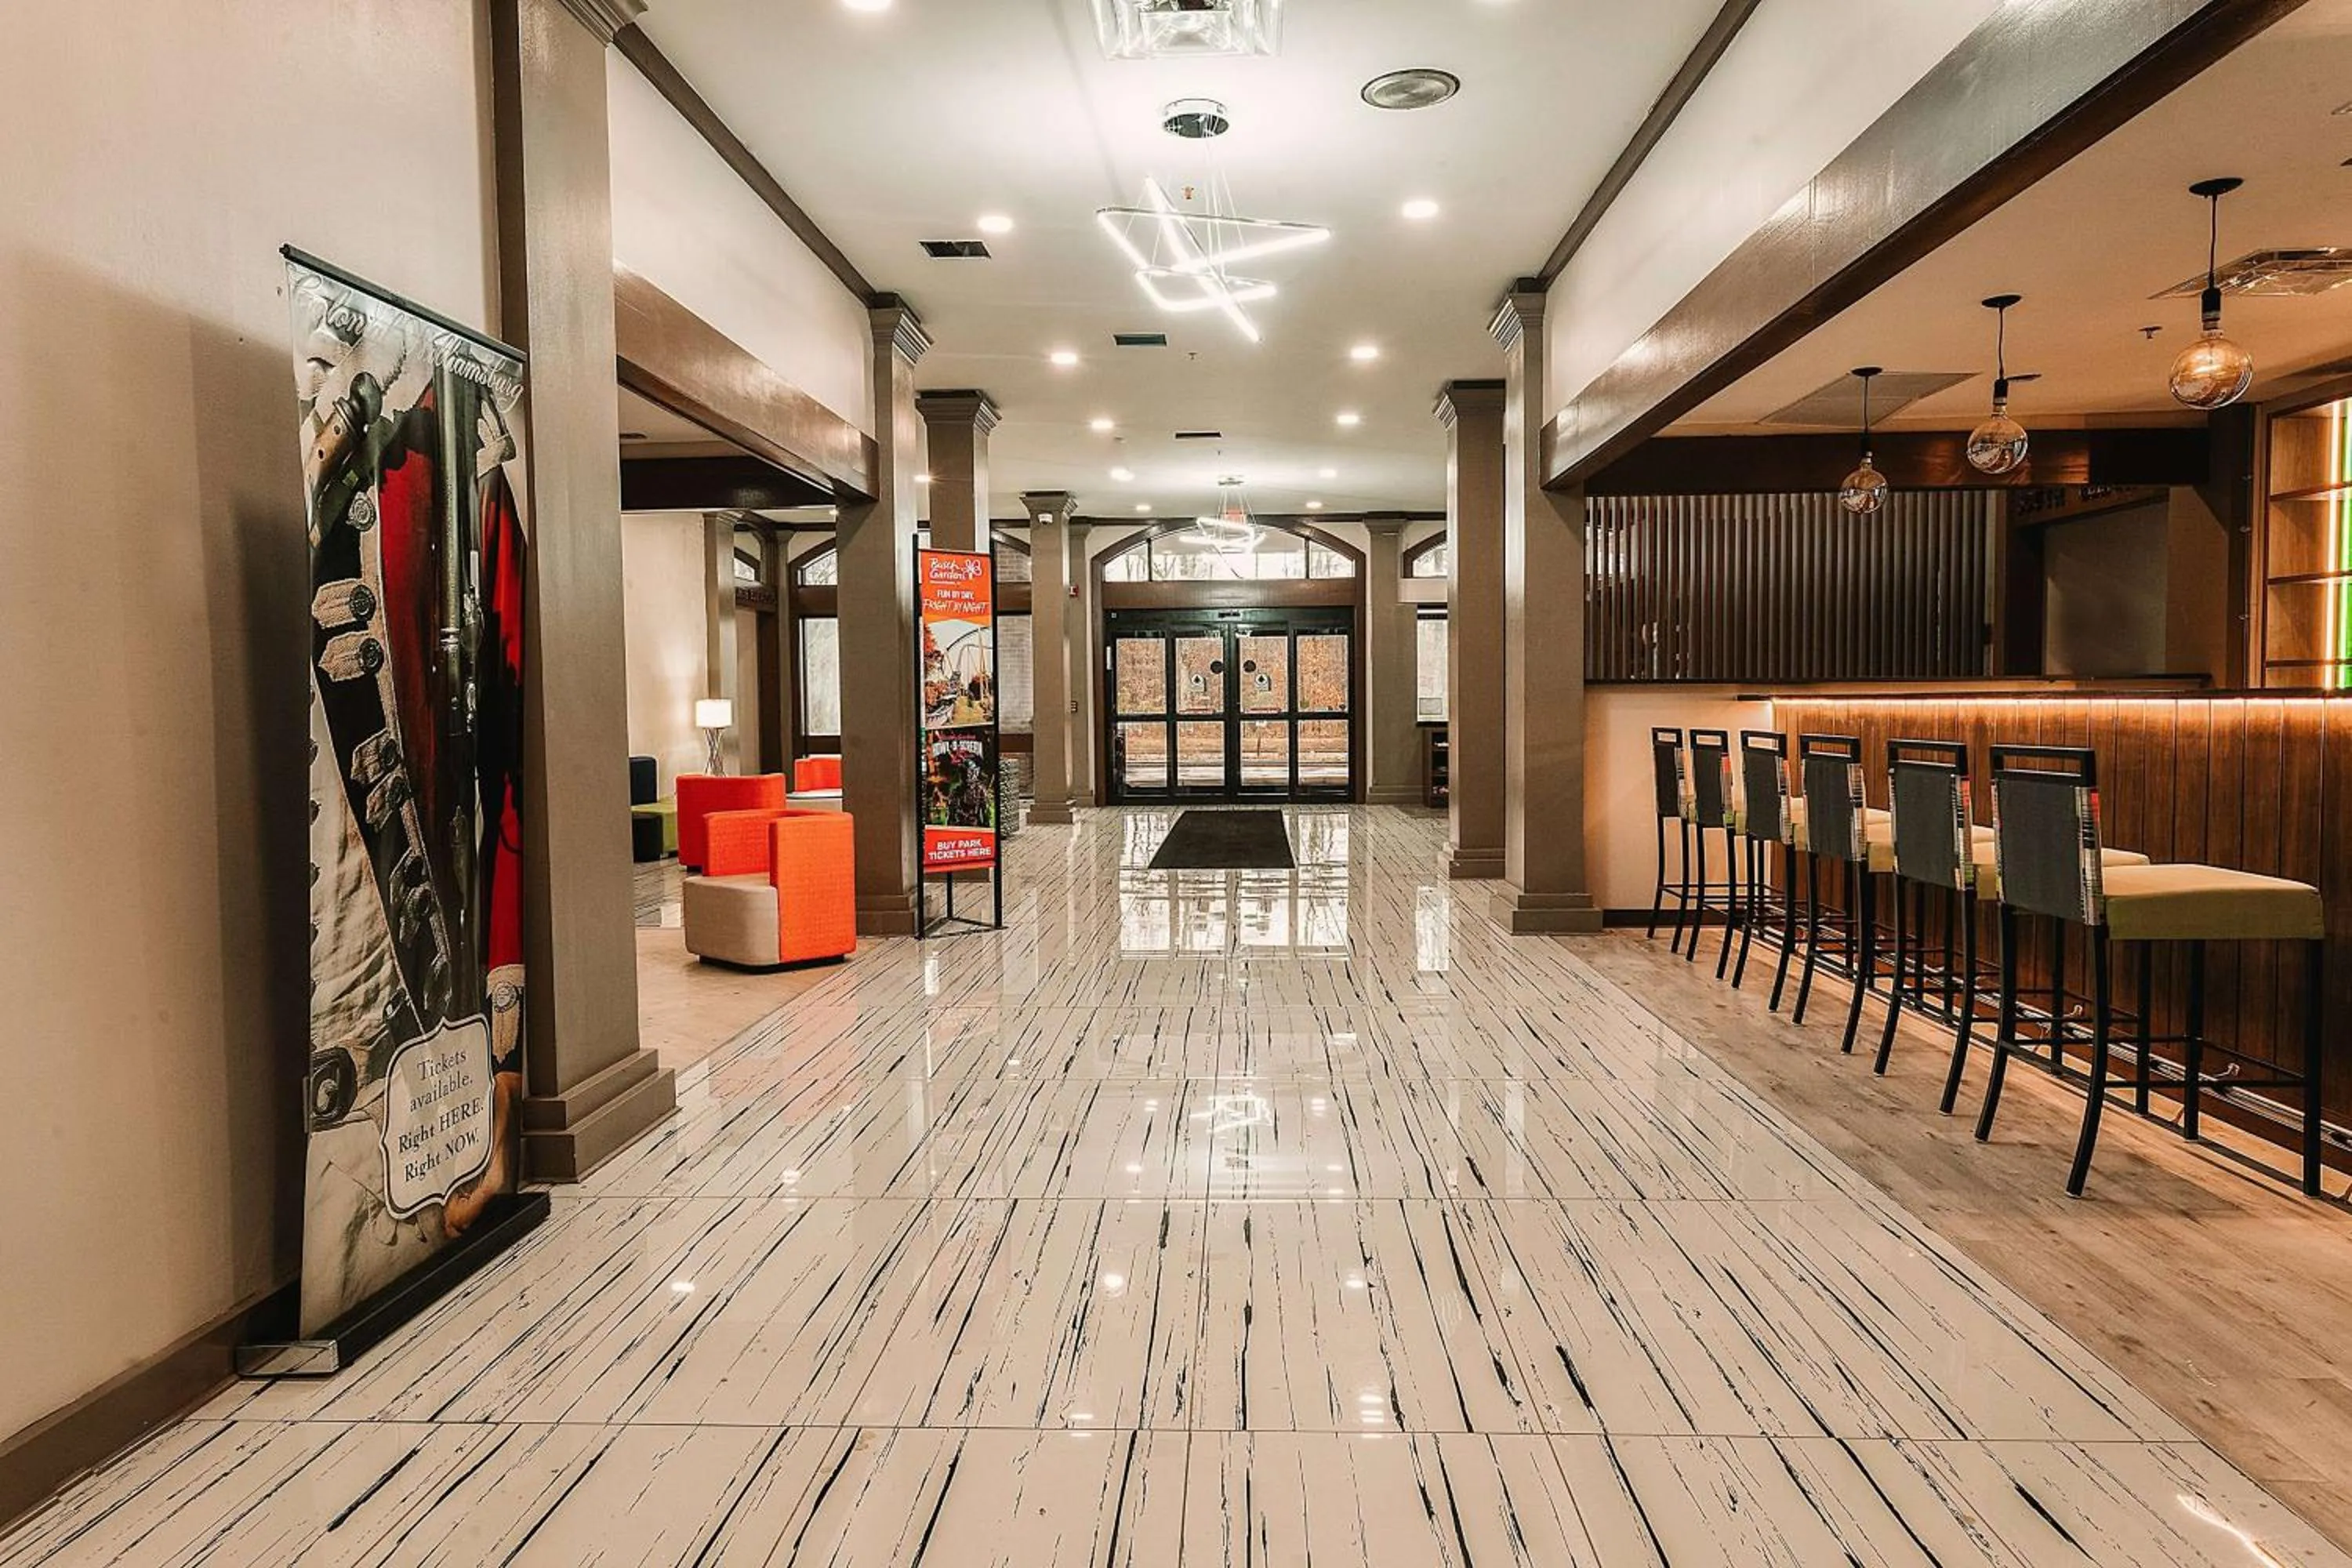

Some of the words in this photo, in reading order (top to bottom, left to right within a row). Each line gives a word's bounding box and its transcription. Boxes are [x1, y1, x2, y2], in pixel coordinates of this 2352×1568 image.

[928, 557, 960, 570] Busch
[936, 590, 951, 599] FUN
[928, 849, 966, 860] TICKETS
[967, 847, 992, 857] HERE
[936, 840, 956, 851] BUY
[957, 838, 982, 848] PARK
[416, 1049, 466, 1082] Tickets
[409, 1074, 473, 1112] available.
[397, 1123, 435, 1153] Right
[438, 1097, 484, 1132] HERE.
[404, 1151, 441, 1182] Right
[445, 1127, 480, 1160] NOW.
